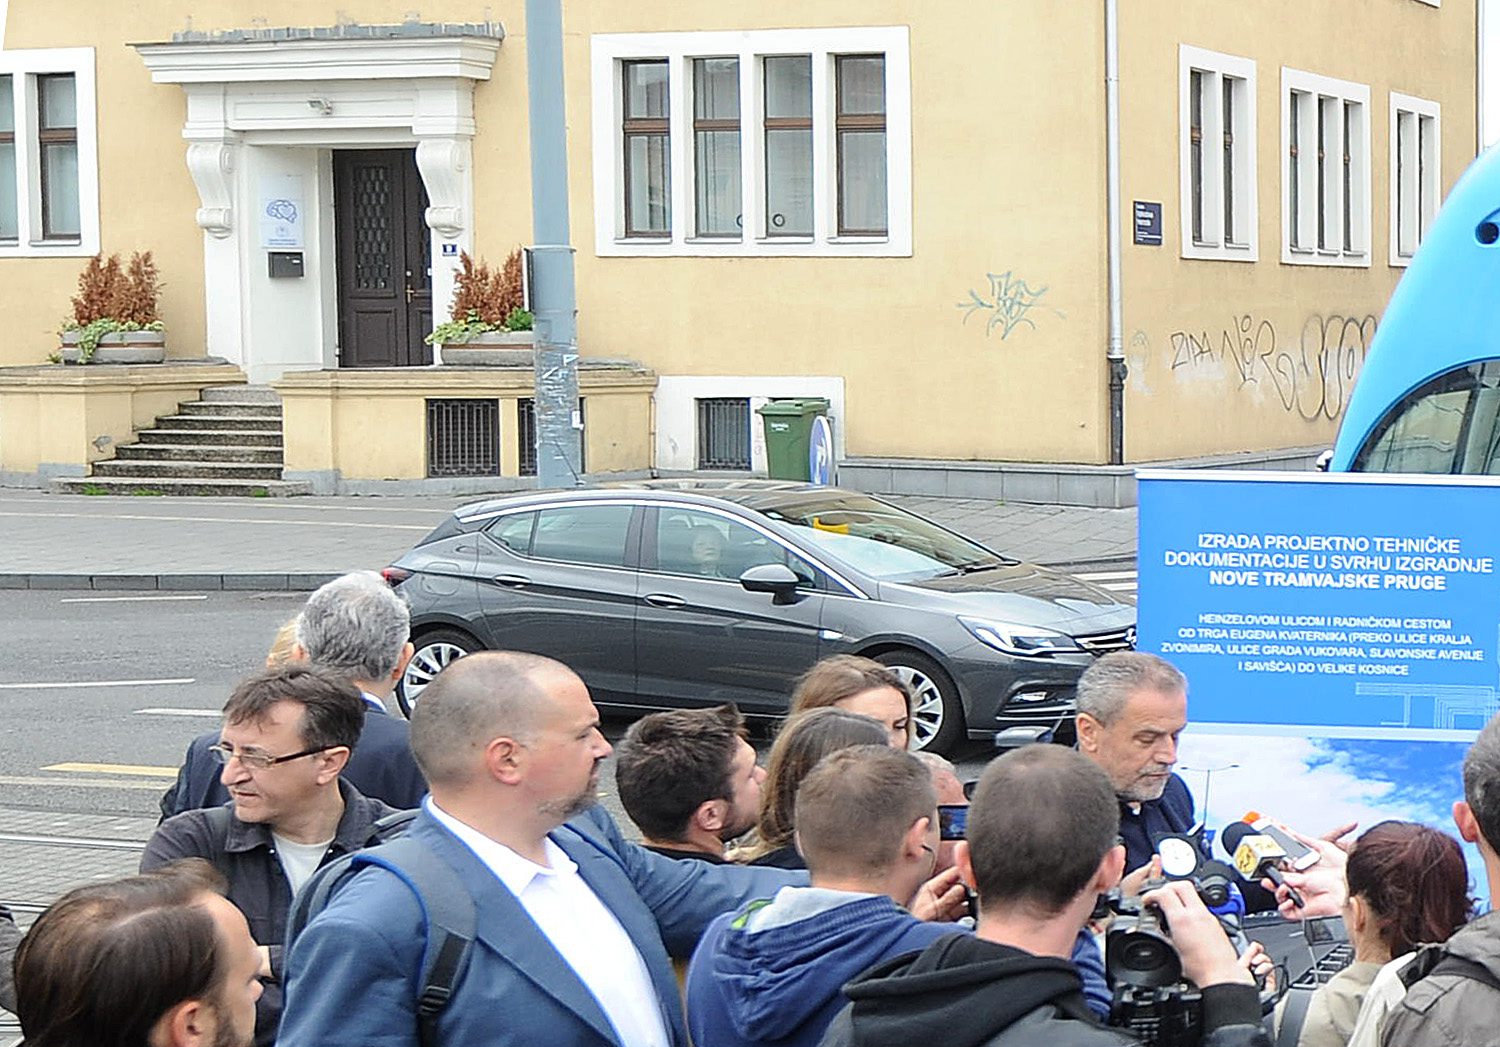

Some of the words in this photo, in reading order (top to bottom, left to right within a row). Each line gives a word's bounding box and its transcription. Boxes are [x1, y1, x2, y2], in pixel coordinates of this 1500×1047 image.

[1198, 533, 1261, 549] IZRADA
[1264, 535, 1370, 552] PROJEKTNO
[1372, 535, 1461, 554] TEHNIČKE
[1164, 550, 1310, 569] DOKUMENTACIJE
[1313, 554, 1327, 569] U
[1330, 554, 1391, 571] SVRHU
[1395, 556, 1494, 573] IZGRADNJE
[1209, 570, 1260, 586] NOVE
[1262, 571, 1380, 589] TRAMVAJSKE
[1383, 574, 1446, 591] PRUGE
[1198, 613, 1280, 626] HEINZELOVOM
[1281, 615, 1325, 627] ULICOM
[1326, 616, 1332, 627] I
[1333, 616, 1402, 629] RADNIČKOM
[1403, 618, 1452, 630] CESTOM
[1178, 627, 1196, 638] OD
[1197, 628, 1229, 639] TRGA
[1230, 629, 1277, 641] EUGENA
[1278, 631, 1347, 643] KVATERNIKA
[1348, 632, 1392, 644] (PREKO
[1393, 633, 1427, 644] ULICE
[1429, 634, 1473, 645] KRALJA
[1160, 642, 1225, 655] ZVONIMIRA,
[1227, 644, 1260, 655] ULICE
[1262, 645, 1302, 656] GRADA
[1303, 646, 1367, 659] VUKOVARA,
[1369, 647, 1437, 660] SLAVONSKE
[1438, 650, 1484, 661] AVENIJE
[1237, 661, 1242, 671] I
[1297, 662, 1315, 673] DO
[1316, 662, 1357, 674] VELIKE
[1358, 664, 1409, 676] KOSNICE
